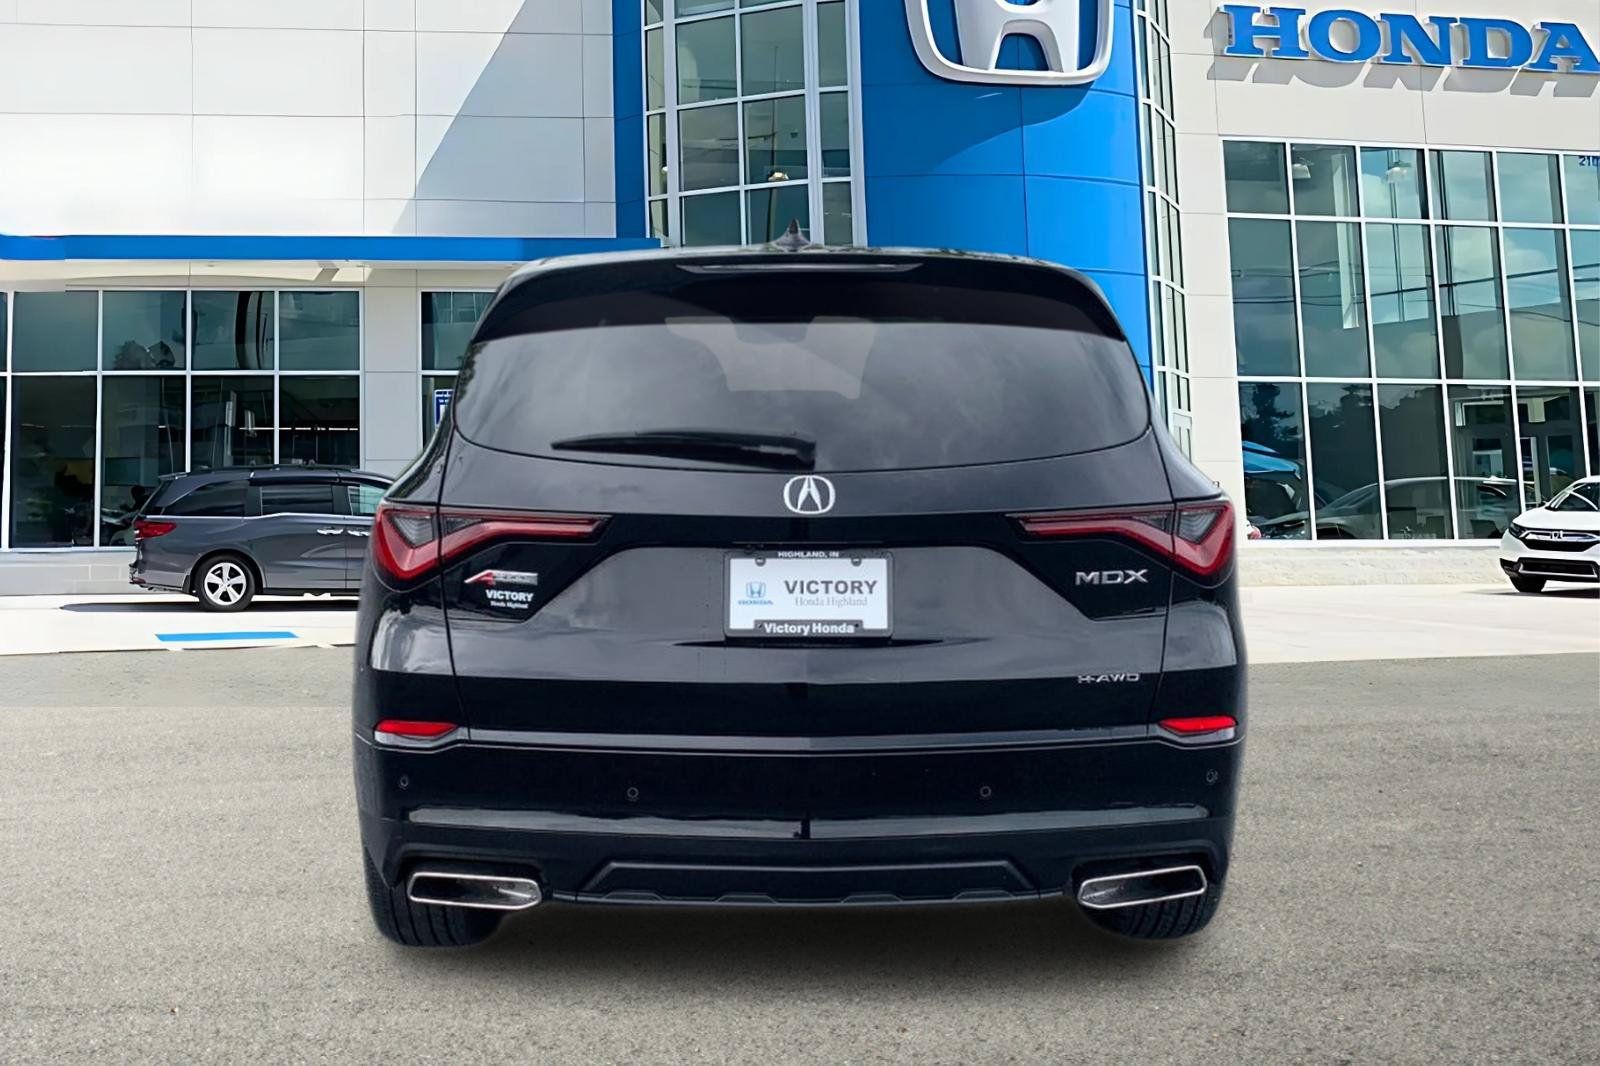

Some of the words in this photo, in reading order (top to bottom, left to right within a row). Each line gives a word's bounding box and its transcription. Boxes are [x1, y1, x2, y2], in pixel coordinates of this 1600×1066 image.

[1223, 4, 1600, 73] HONDA
[1075, 569, 1148, 585] MDX
[784, 580, 878, 595] VICTORY
[485, 589, 534, 602] VICTORY
[795, 597, 825, 606] Honda
[826, 596, 868, 608] Highland
[763, 622, 810, 635] Victory
[812, 622, 855, 634] Honda
